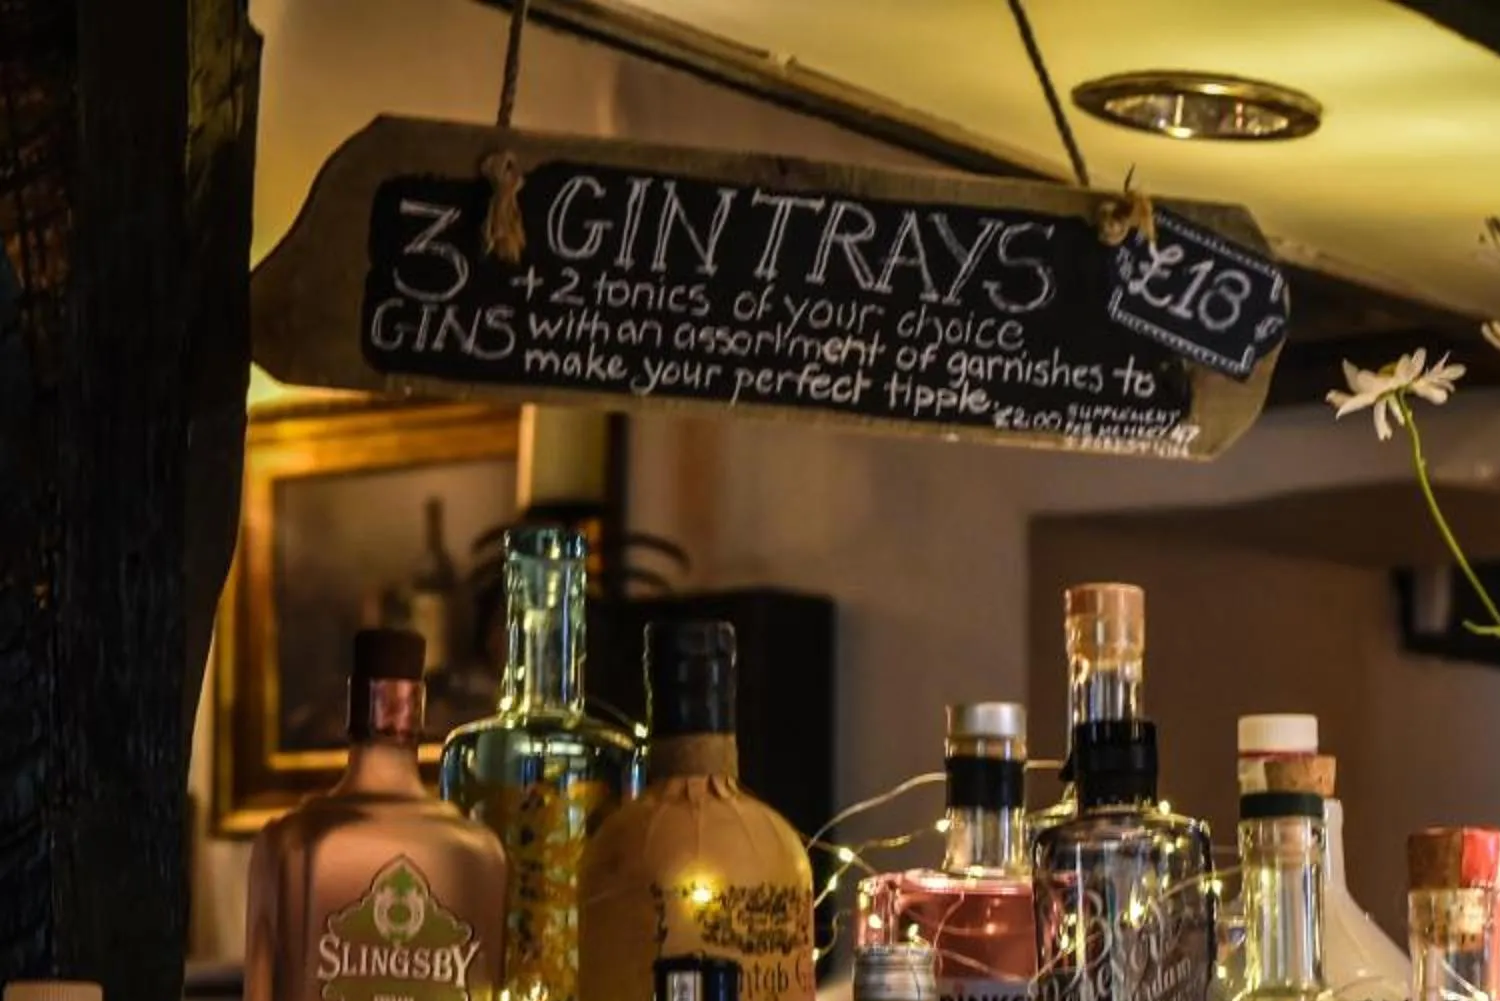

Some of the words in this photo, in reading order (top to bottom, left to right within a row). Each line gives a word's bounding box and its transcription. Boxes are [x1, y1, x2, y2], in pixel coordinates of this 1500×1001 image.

[393, 199, 470, 301] 3
[752, 188, 1057, 313] TRAYS
[1128, 240, 1252, 332] £18
[370, 297, 516, 359] GINS
[594, 270, 711, 316] tonics
[732, 280, 775, 323] of
[782, 292, 885, 345] your
[896, 303, 1026, 351] choice
[523, 344, 629, 383] make
[630, 358, 722, 397] your
[730, 364, 873, 408] perfect
[528, 308, 611, 348] with
[616, 318, 664, 348] an
[673, 324, 885, 369] assortment
[895, 343, 939, 371] of
[946, 346, 1105, 395] garnishes
[1112, 355, 1157, 397] to
[316, 933, 481, 988] SLINGSBY
